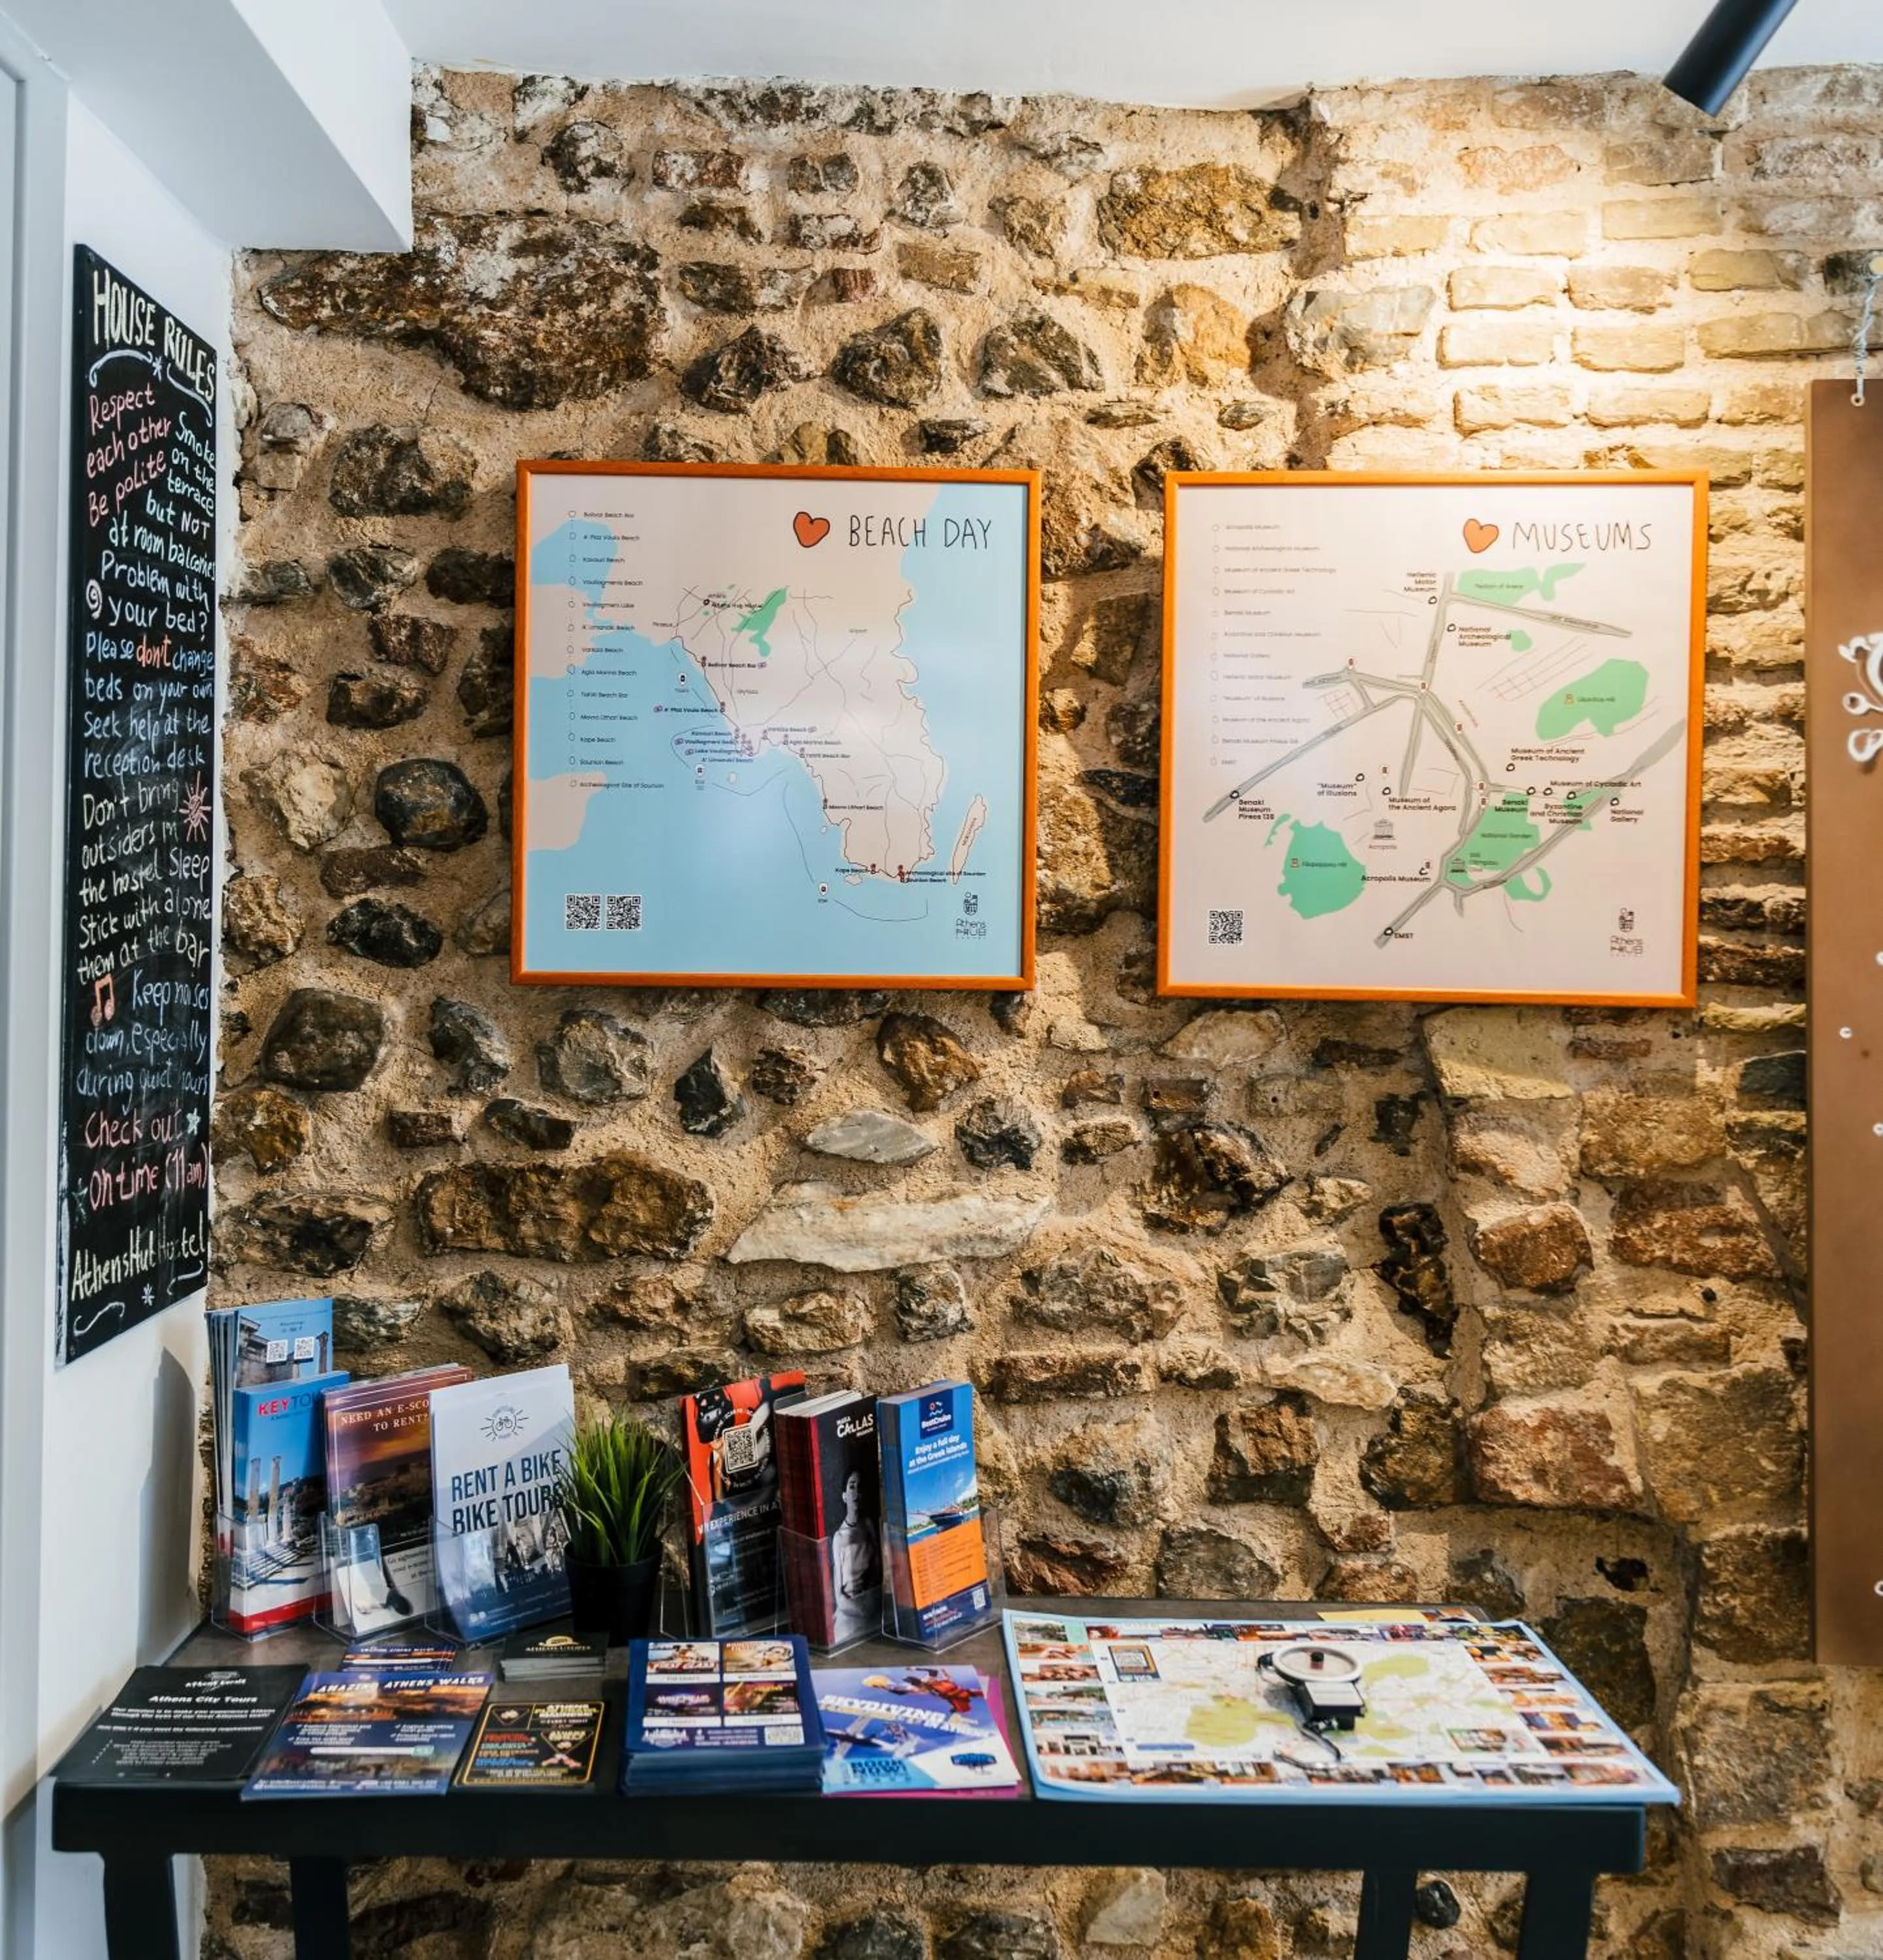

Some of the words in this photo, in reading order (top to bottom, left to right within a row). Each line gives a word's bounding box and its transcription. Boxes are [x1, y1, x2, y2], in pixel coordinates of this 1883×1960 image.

[93, 269, 157, 350] HOUSE
[163, 316, 216, 404] RULES
[90, 382, 156, 436] Respect
[86, 433, 124, 480] each
[128, 416, 172, 451] other
[174, 411, 216, 470] Smoke
[167, 468, 215, 518] terrace
[171, 448, 189, 474] on
[195, 465, 216, 495] the
[88, 492, 109, 527] Be
[145, 489, 176, 526] but
[180, 512, 210, 542] NOT
[849, 515, 926, 547] BEACH
[944, 518, 991, 549] DAY
[108, 516, 129, 547] at
[133, 525, 165, 560] room
[1513, 520, 1652, 552] MUSEUMS
[101, 550, 170, 598] Problem
[176, 580, 209, 612] with
[108, 595, 159, 627] your
[165, 602, 208, 642] bed?
[86, 631, 134, 663] Please
[137, 633, 171, 668] don't
[172, 651, 214, 678] change
[85, 673, 123, 702] beds
[133, 682, 154, 701] on
[159, 681, 187, 715] your
[192, 685, 213, 699] own
[83, 711, 122, 738] Seek
[130, 710, 159, 754] help
[164, 715, 180, 735] at
[187, 713, 210, 735] the
[84, 751, 161, 791] reception
[167, 742, 205, 774] desk
[82, 792, 130, 830] Don't
[139, 780, 179, 814] bring
[81, 821, 155, 870] outsiders
[163, 822, 178, 843] in
[169, 847, 210, 891] Sleep
[79, 878, 108, 907] the
[112, 849, 162, 894] hostel
[79, 914, 118, 949] Stick
[123, 898, 159, 931] with
[164, 887, 212, 920] alone
[76, 951, 114, 986] them
[120, 936, 139, 967] at
[148, 925, 170, 953] the
[176, 923, 210, 969] bar
[133, 969, 170, 1026] Keep
[76, 1066, 134, 1115] during
[85, 1108, 142, 1148] Check
[151, 1107, 182, 1145] out
[340, 1412, 372, 1426] NEED
[377, 1406, 392, 1418] AN
[373, 1422, 388, 1431] TO
[837, 1413, 873, 1437] CALLAS
[451, 1463, 499, 1503] RENT
[504, 1461, 516, 1488] A
[521, 1448, 563, 1483] BIKE
[451, 1498, 498, 1538] BIKE
[384, 1679, 434, 1689] ATHENS
[439, 1676, 485, 1686] WALKS
